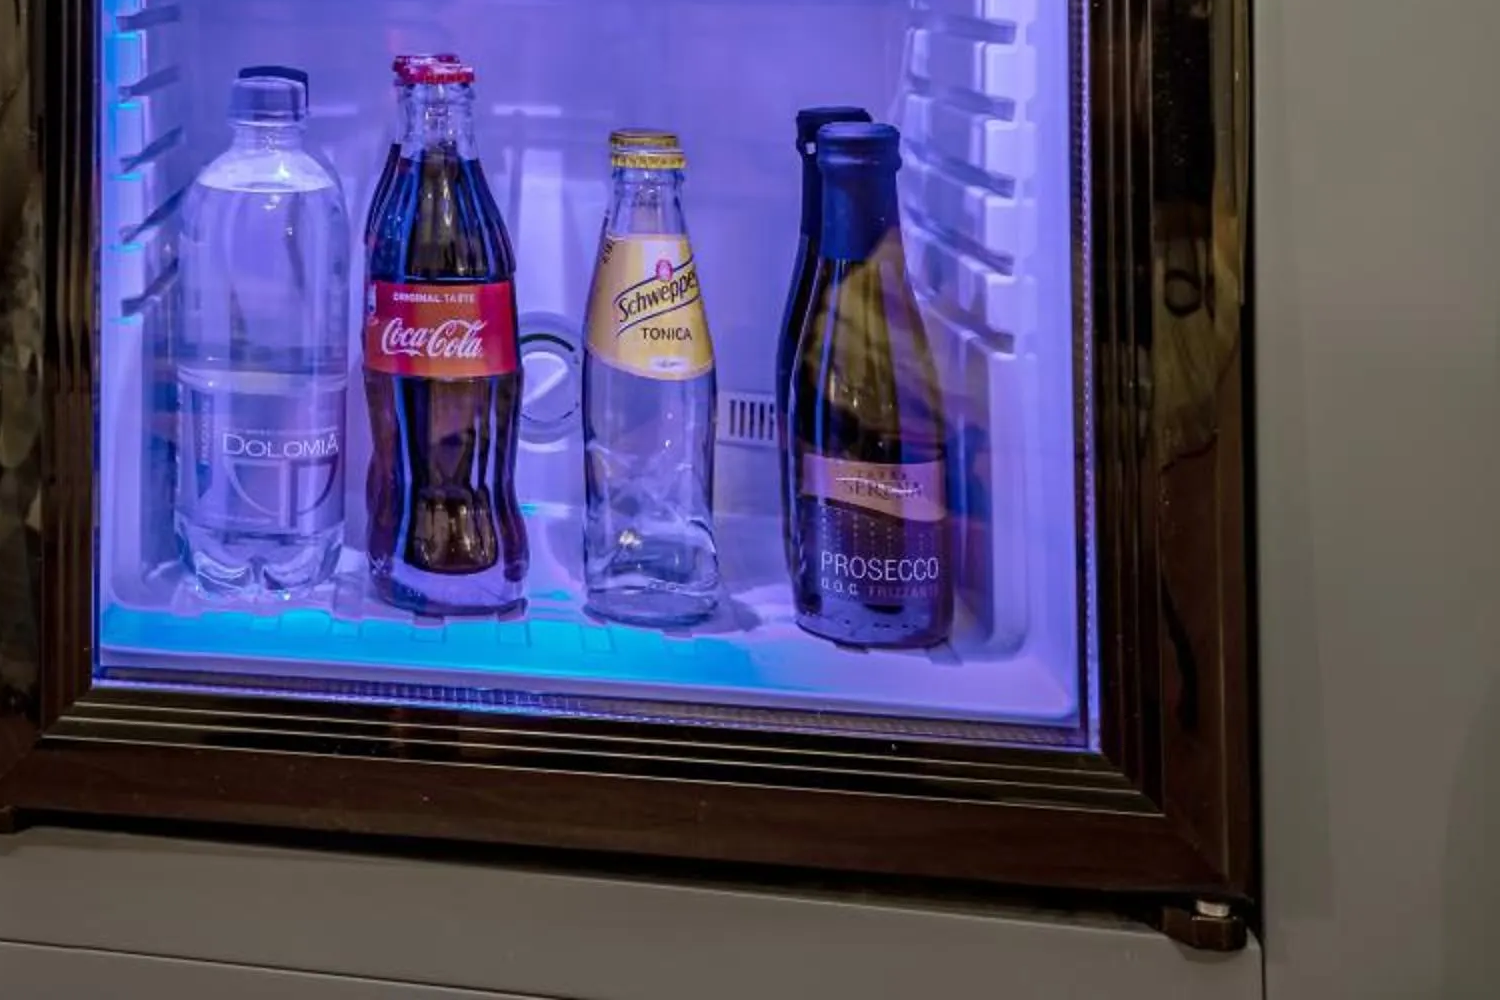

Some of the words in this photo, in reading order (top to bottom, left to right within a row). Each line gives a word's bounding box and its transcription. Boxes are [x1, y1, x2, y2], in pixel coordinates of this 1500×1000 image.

[393, 291, 440, 303] ORIGINAL
[444, 292, 476, 304] TASTE
[618, 268, 699, 323] Schweppe
[642, 327, 693, 341] TONICA
[223, 431, 339, 459] DOLOMIA
[821, 551, 939, 581] PROSECCO
